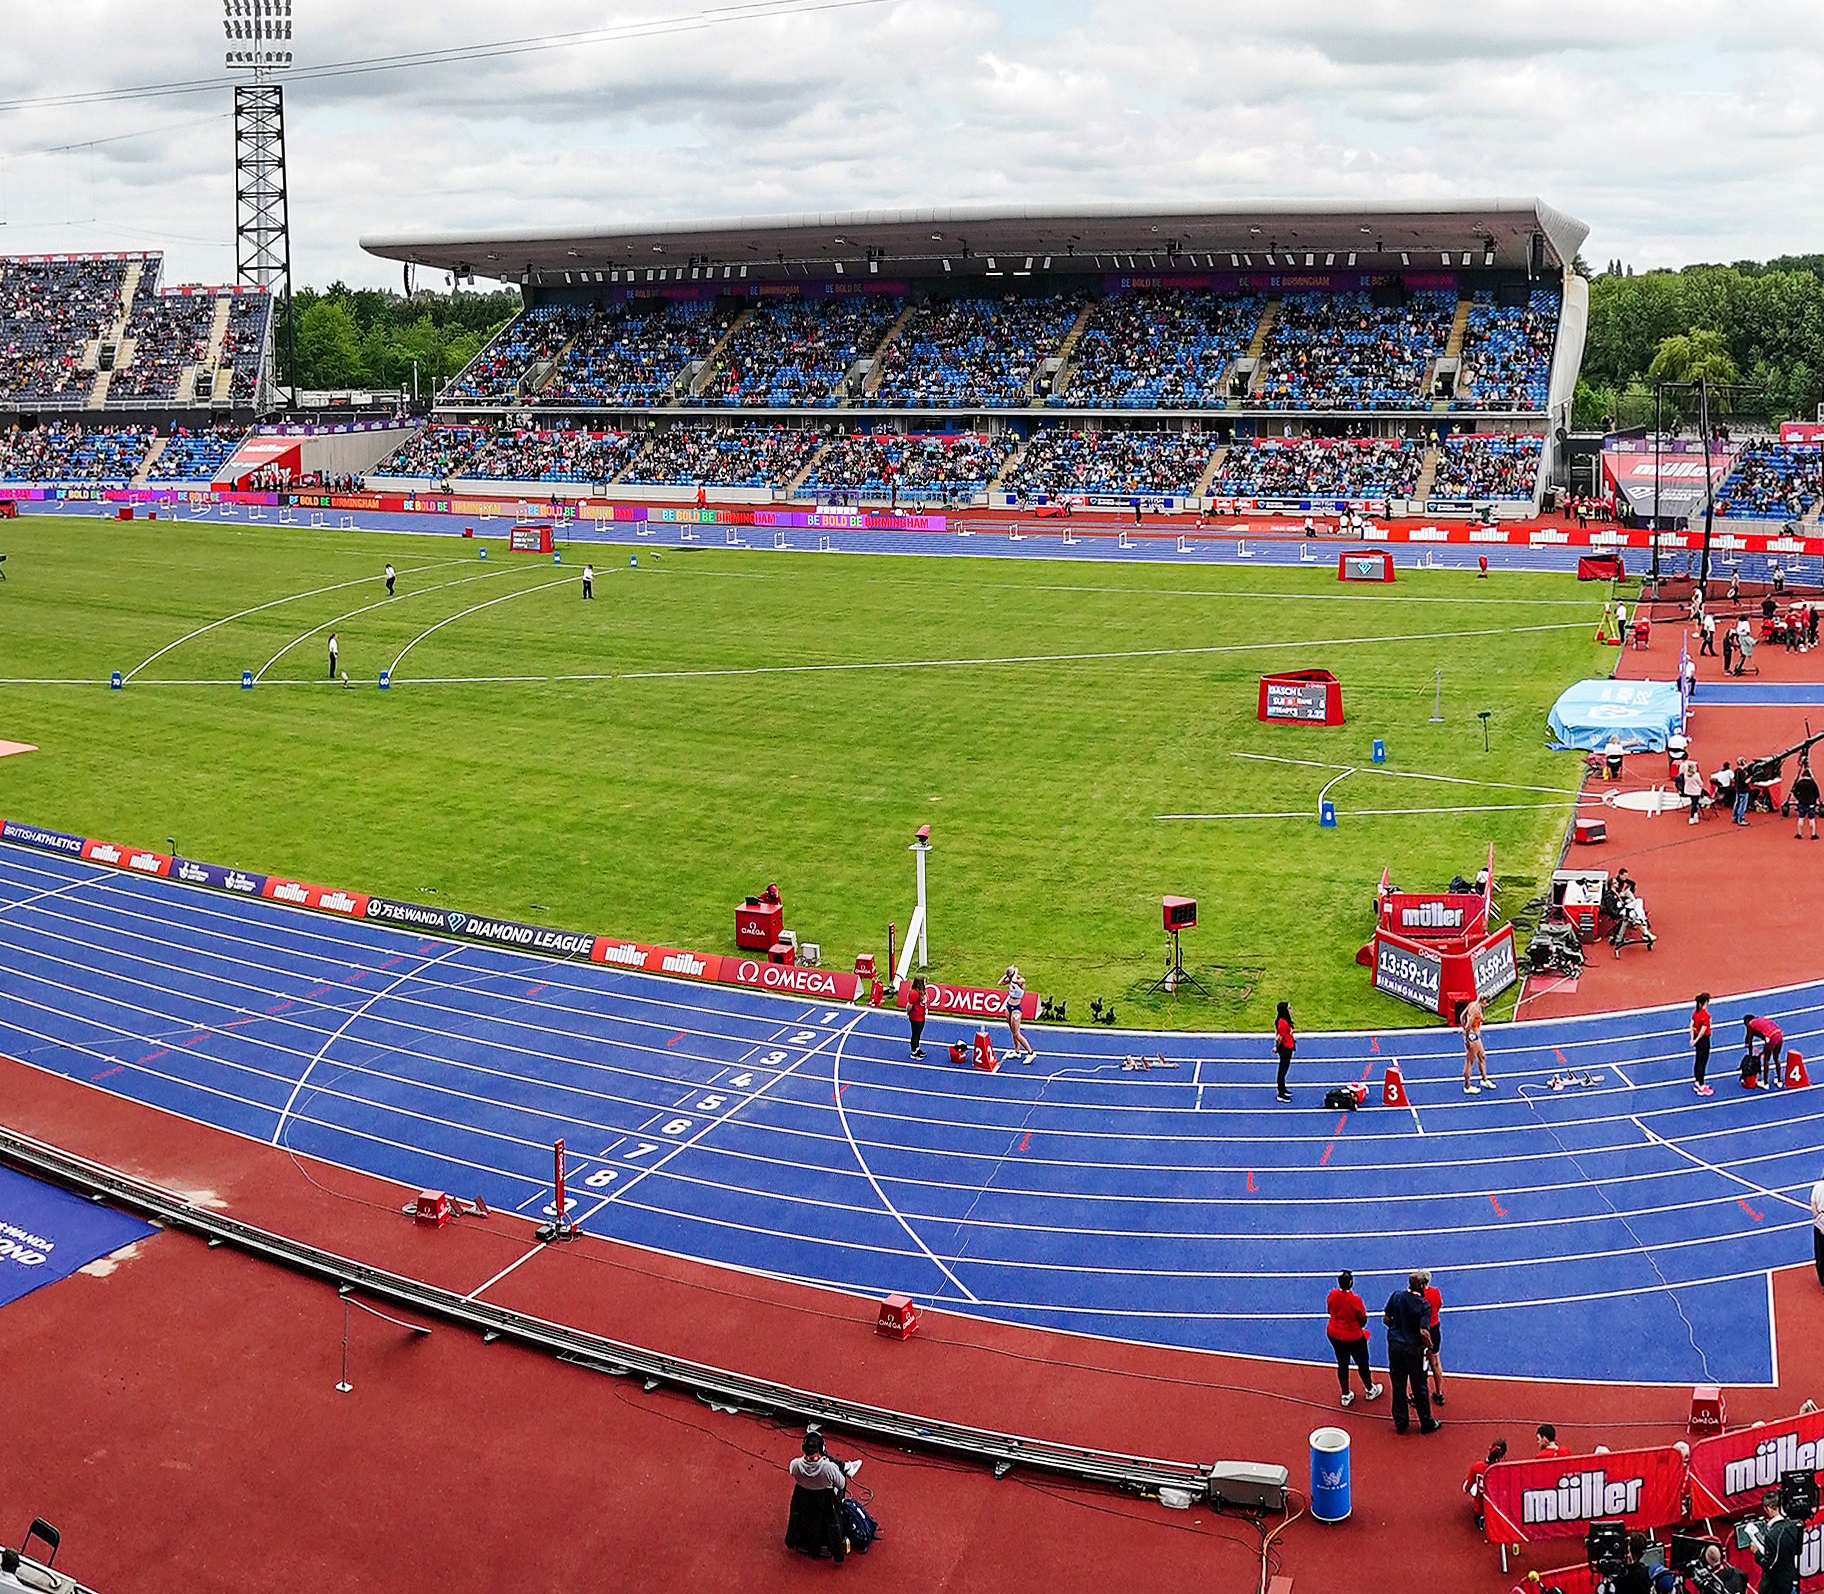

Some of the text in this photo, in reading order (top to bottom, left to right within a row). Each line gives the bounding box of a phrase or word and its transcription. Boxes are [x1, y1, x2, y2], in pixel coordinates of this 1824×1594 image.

[1632, 462, 1725, 477] müller
[68, 490, 89, 499] BOLD
[178, 492, 188, 501] BE
[300, 496, 319, 506] BOLD
[320, 497, 330, 506] BE
[332, 497, 379, 509] BIRMINGHAM
[404, 501, 448, 512] BE BOLD BE
[528, 505, 634, 520] BE BOLD BE BIRMINGHAM
[663, 510, 776, 524] BE BOLD BE BIRMINGHAM
[807, 516, 928, 529] BE BOLD BE BIRMINGHAM
[1409, 526, 1449, 541] müller
[1469, 526, 1510, 541] müller
[1529, 528, 1570, 543] müller
[1589, 530, 1630, 545] müller
[1708, 534, 1747, 549] müller
[1766, 537, 1806, 553] müller
[89, 844, 161, 873] müller müller
[273, 882, 356, 913] müller müller
[1402, 902, 1464, 927] müller
[466, 919, 532, 944] DIAMOND
[534, 930, 594, 955] LEAGUE
[741, 927, 765, 938] OMEGA
[605, 944, 706, 977] müller müller
[1474, 946, 1513, 990] 13:59:14
[1379, 951, 1440, 993] 13:59:14
[764, 968, 836, 994] OMEGA
[1376, 974, 1426, 1003] BIRMINGHAM
[820, 1012, 840, 1024] 1
[787, 1031, 817, 1044] 2
[760, 1051, 788, 1065] 3
[975, 1047, 983, 1064] 2
[728, 1073, 754, 1088] 4
[1790, 1065, 1802, 1082] 4
[1388, 1084, 1398, 1101] 3
[696, 1094, 727, 1110] 5
[661, 1118, 693, 1135] 6
[623, 1143, 659, 1159] 7
[584, 1169, 619, 1187] 8
[878, 1320, 902, 1330] OMEGA
[1523, 1469, 1644, 1524] müller
